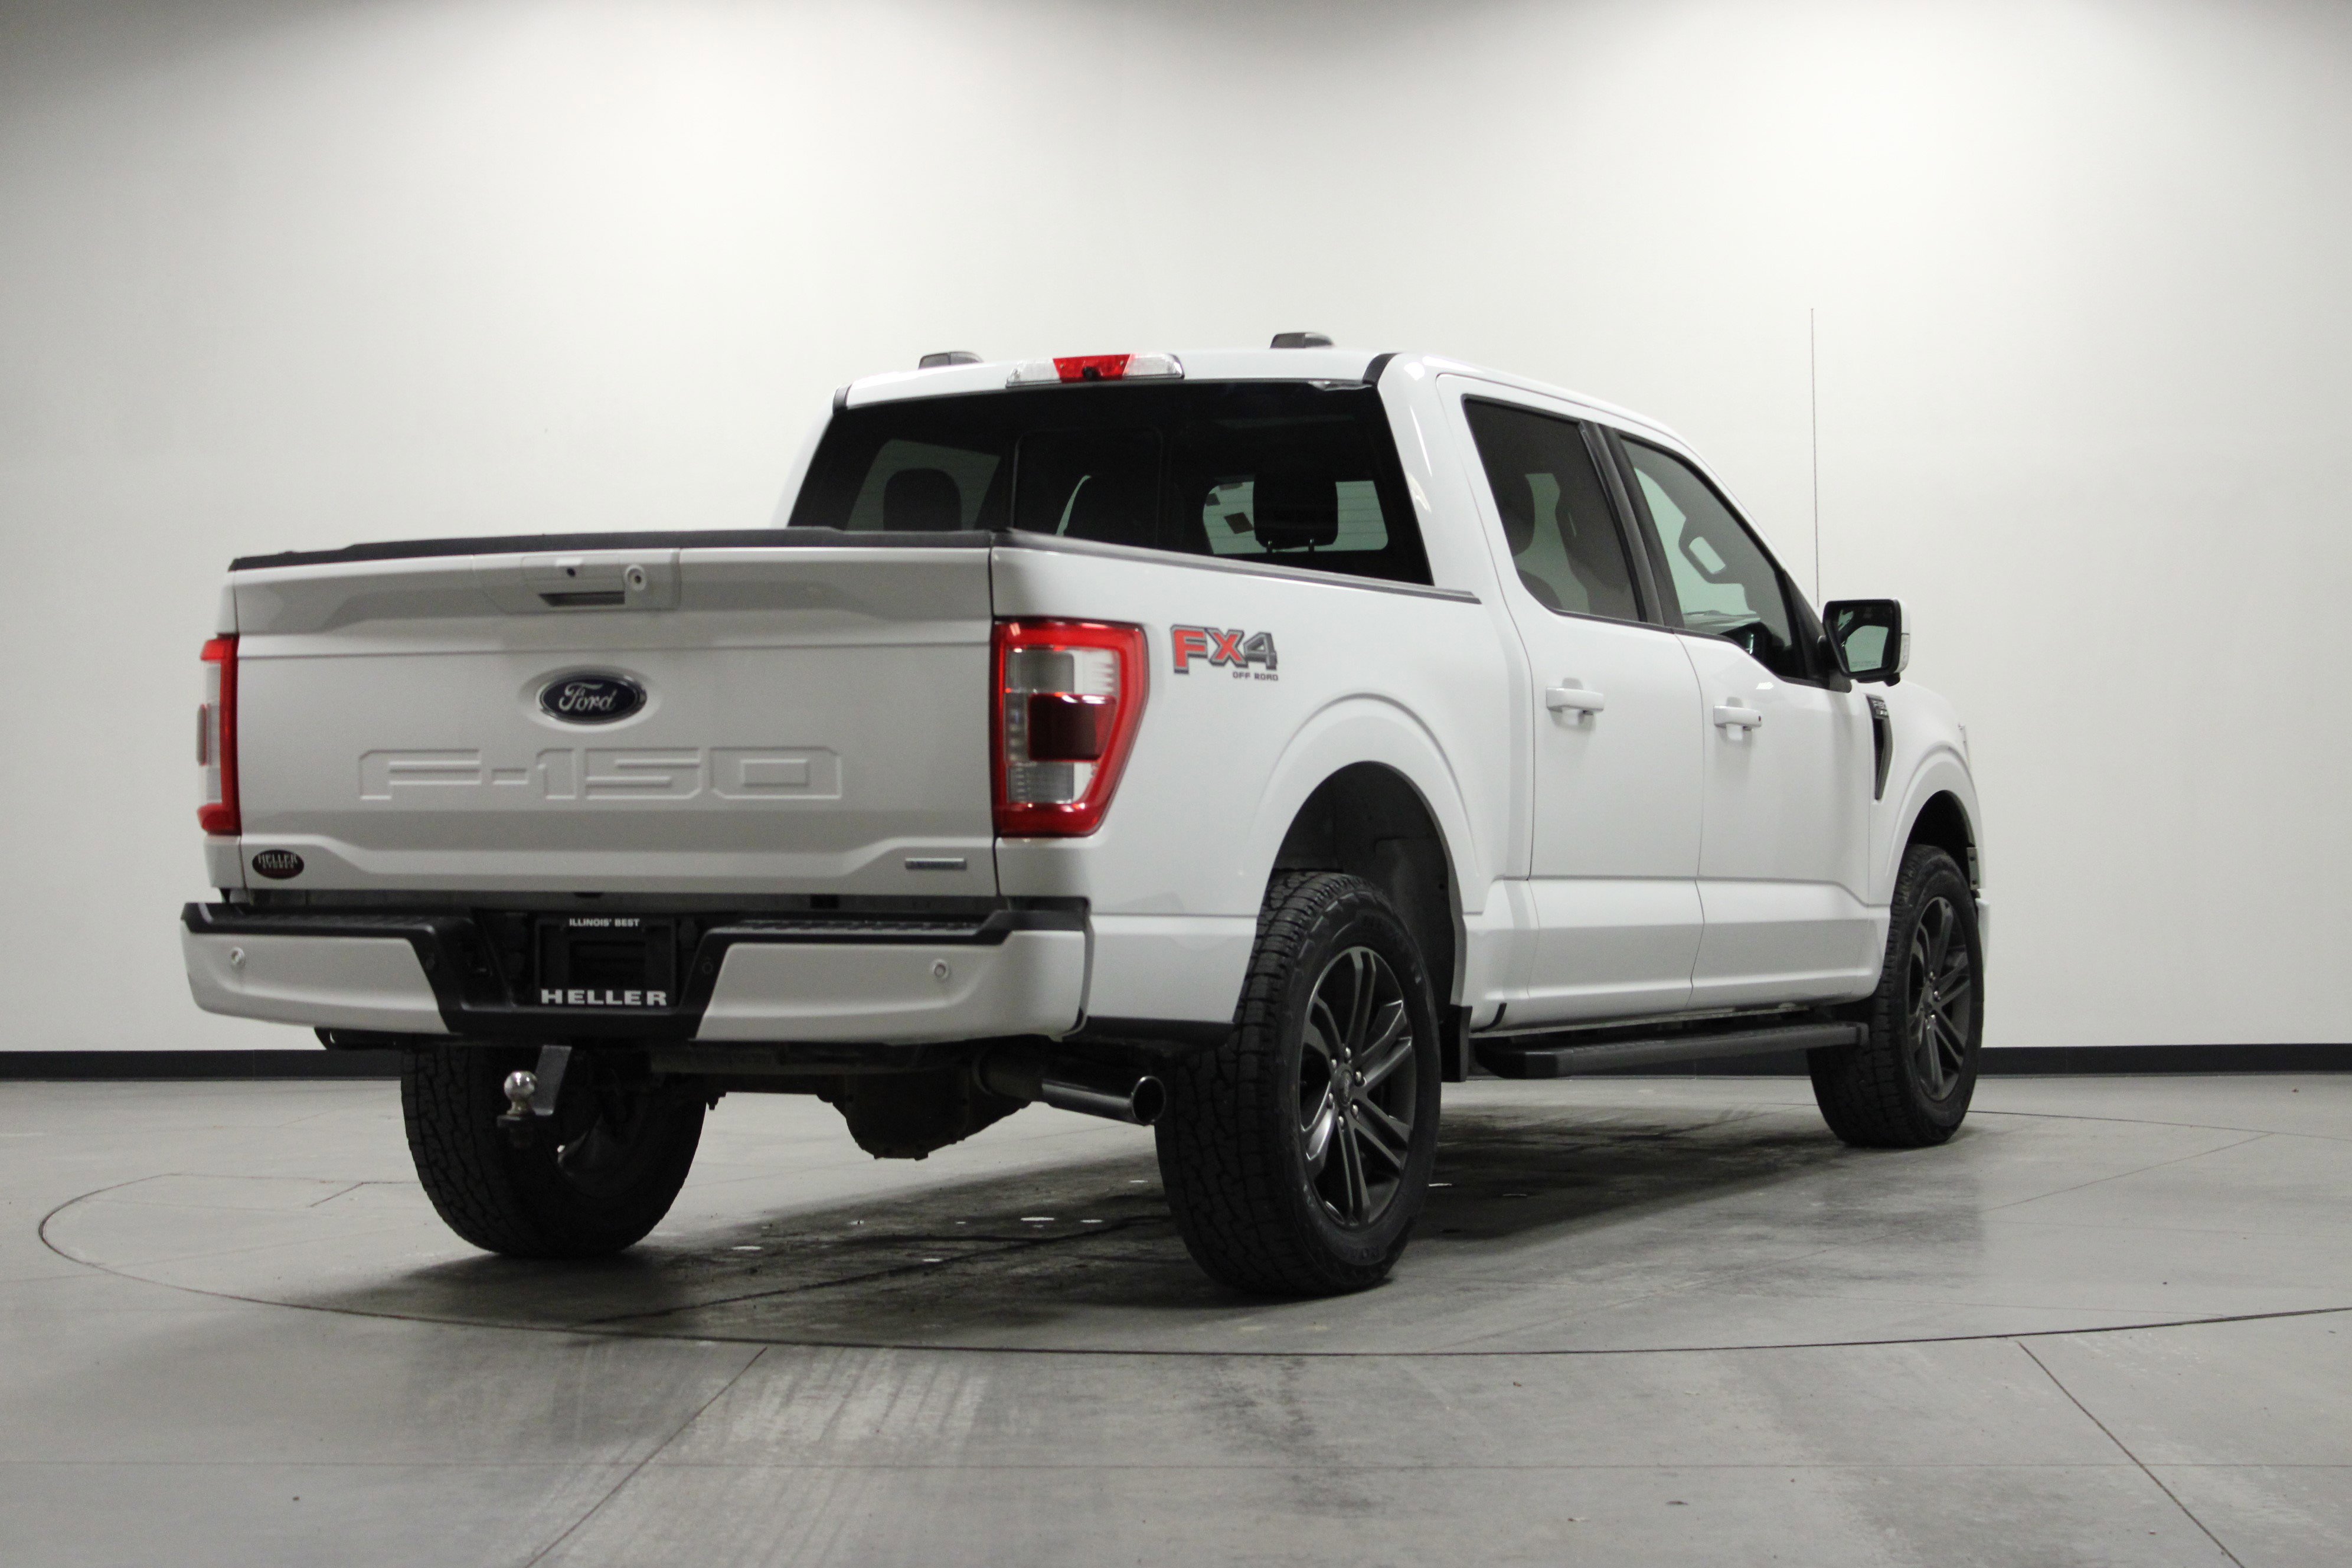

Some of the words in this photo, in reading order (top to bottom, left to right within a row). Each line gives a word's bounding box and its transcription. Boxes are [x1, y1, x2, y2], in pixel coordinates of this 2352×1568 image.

[1170, 624, 1278, 674] FX4
[1232, 671, 1251, 680] OFF
[1254, 672, 1279, 682] ROAD
[558, 682, 618, 711] Ford
[359, 746, 842, 800] F-150
[614, 918, 641, 927] BEST
[541, 988, 667, 1006] HELLER
